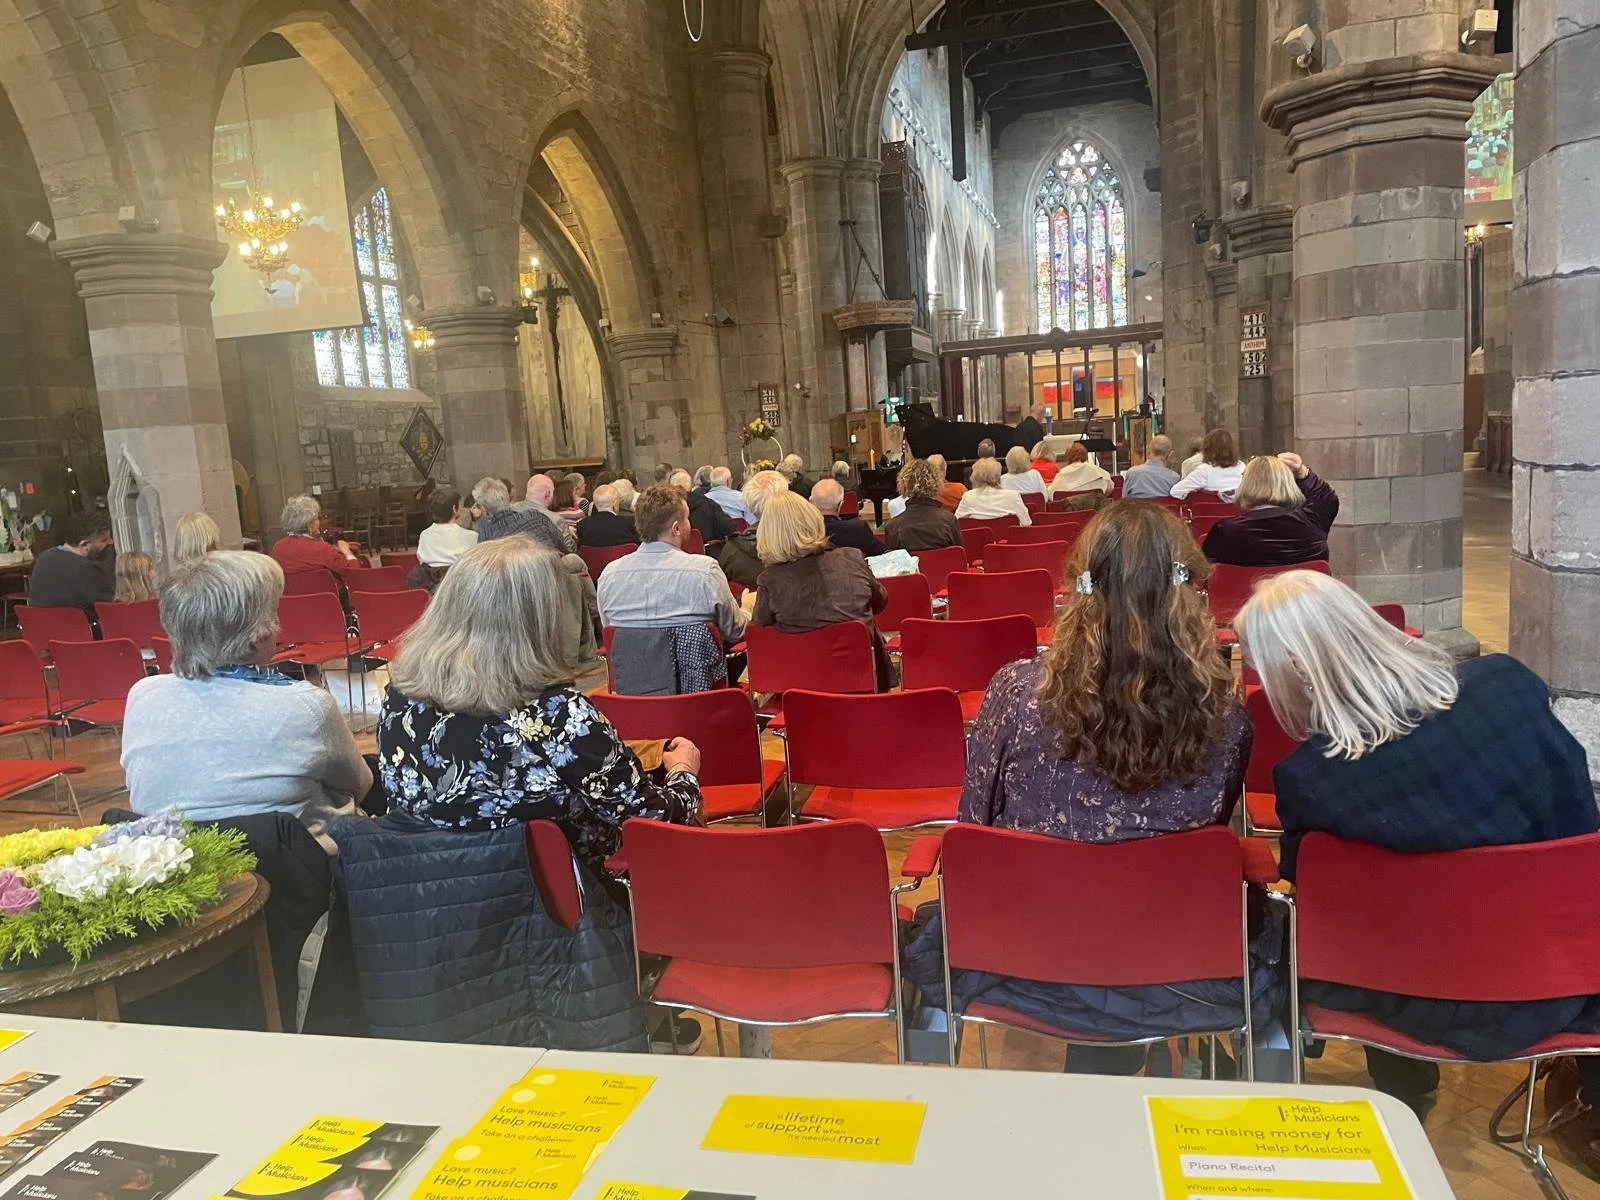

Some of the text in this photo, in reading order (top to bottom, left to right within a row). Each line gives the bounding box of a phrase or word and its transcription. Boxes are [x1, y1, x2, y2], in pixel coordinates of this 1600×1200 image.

[1243, 340, 1265, 349] ANTHEM
[1248, 351, 1267, 362] 502
[1249, 364, 1266, 375] 251
[499, 1106, 566, 1118] Love music?
[1291, 1104, 1321, 1114] Help
[489, 1114, 602, 1133] Help musicians
[784, 1111, 845, 1125] lifetime
[1293, 1113, 1360, 1123] Musicians
[321, 1120, 341, 1128] Help
[756, 1121, 821, 1133] support
[480, 1129, 502, 1137] Take
[1174, 1124, 1363, 1140] I'm raising money for
[305, 1135, 324, 1143] Help
[837, 1135, 881, 1146] most
[298, 1141, 338, 1153] Musicians
[1255, 1143, 1371, 1155] Help Musicians
[273, 1163, 294, 1172] Help
[442, 1164, 517, 1175] Love music?
[1189, 1161, 1276, 1173] Piano Recital
[266, 1170, 308, 1182] Musicians
[433, 1175, 560, 1190] Help musicians
[1186, 1184, 1216, 1192] When
[424, 1192, 448, 1200] Take
[617, 1188, 640, 1198] Help
